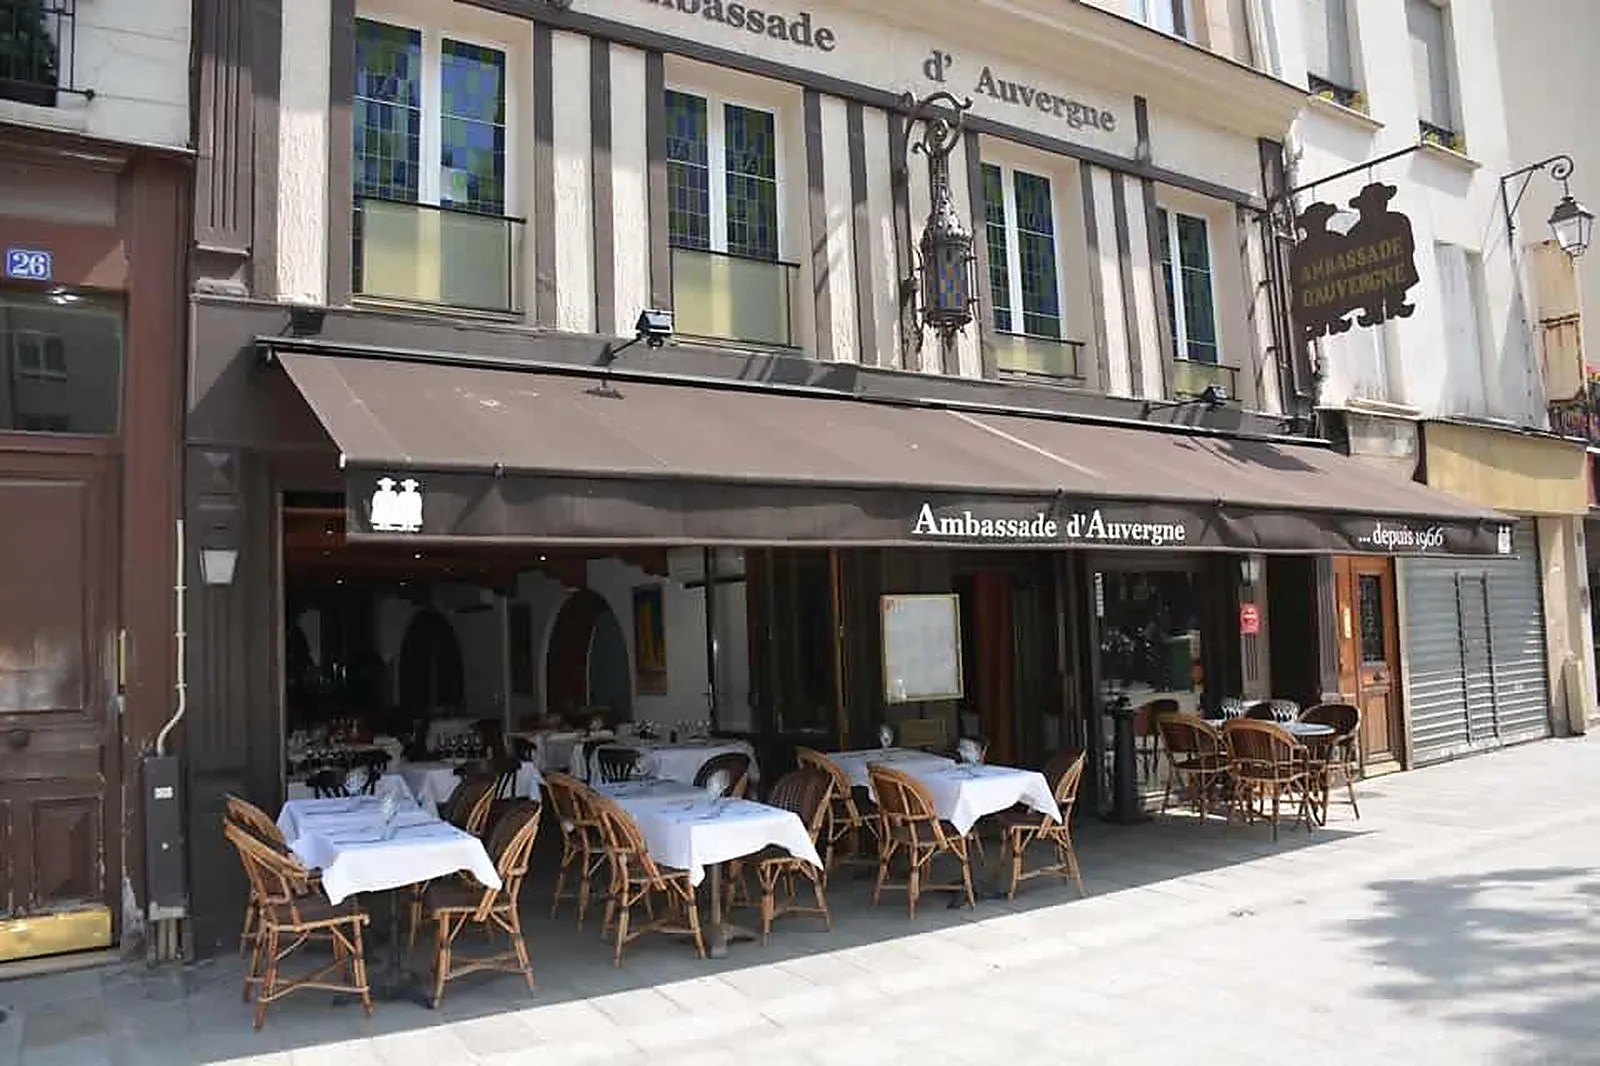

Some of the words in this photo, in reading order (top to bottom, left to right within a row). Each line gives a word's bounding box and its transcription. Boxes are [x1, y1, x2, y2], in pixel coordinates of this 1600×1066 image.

[641, 0, 836, 51] assade
[973, 66, 1116, 132] Auvergne
[12, 252, 46, 276] 26
[912, 503, 1057, 537] Ambassade
[1066, 509, 1186, 545] d'Auvergne
[1415, 527, 1443, 550] 1966
